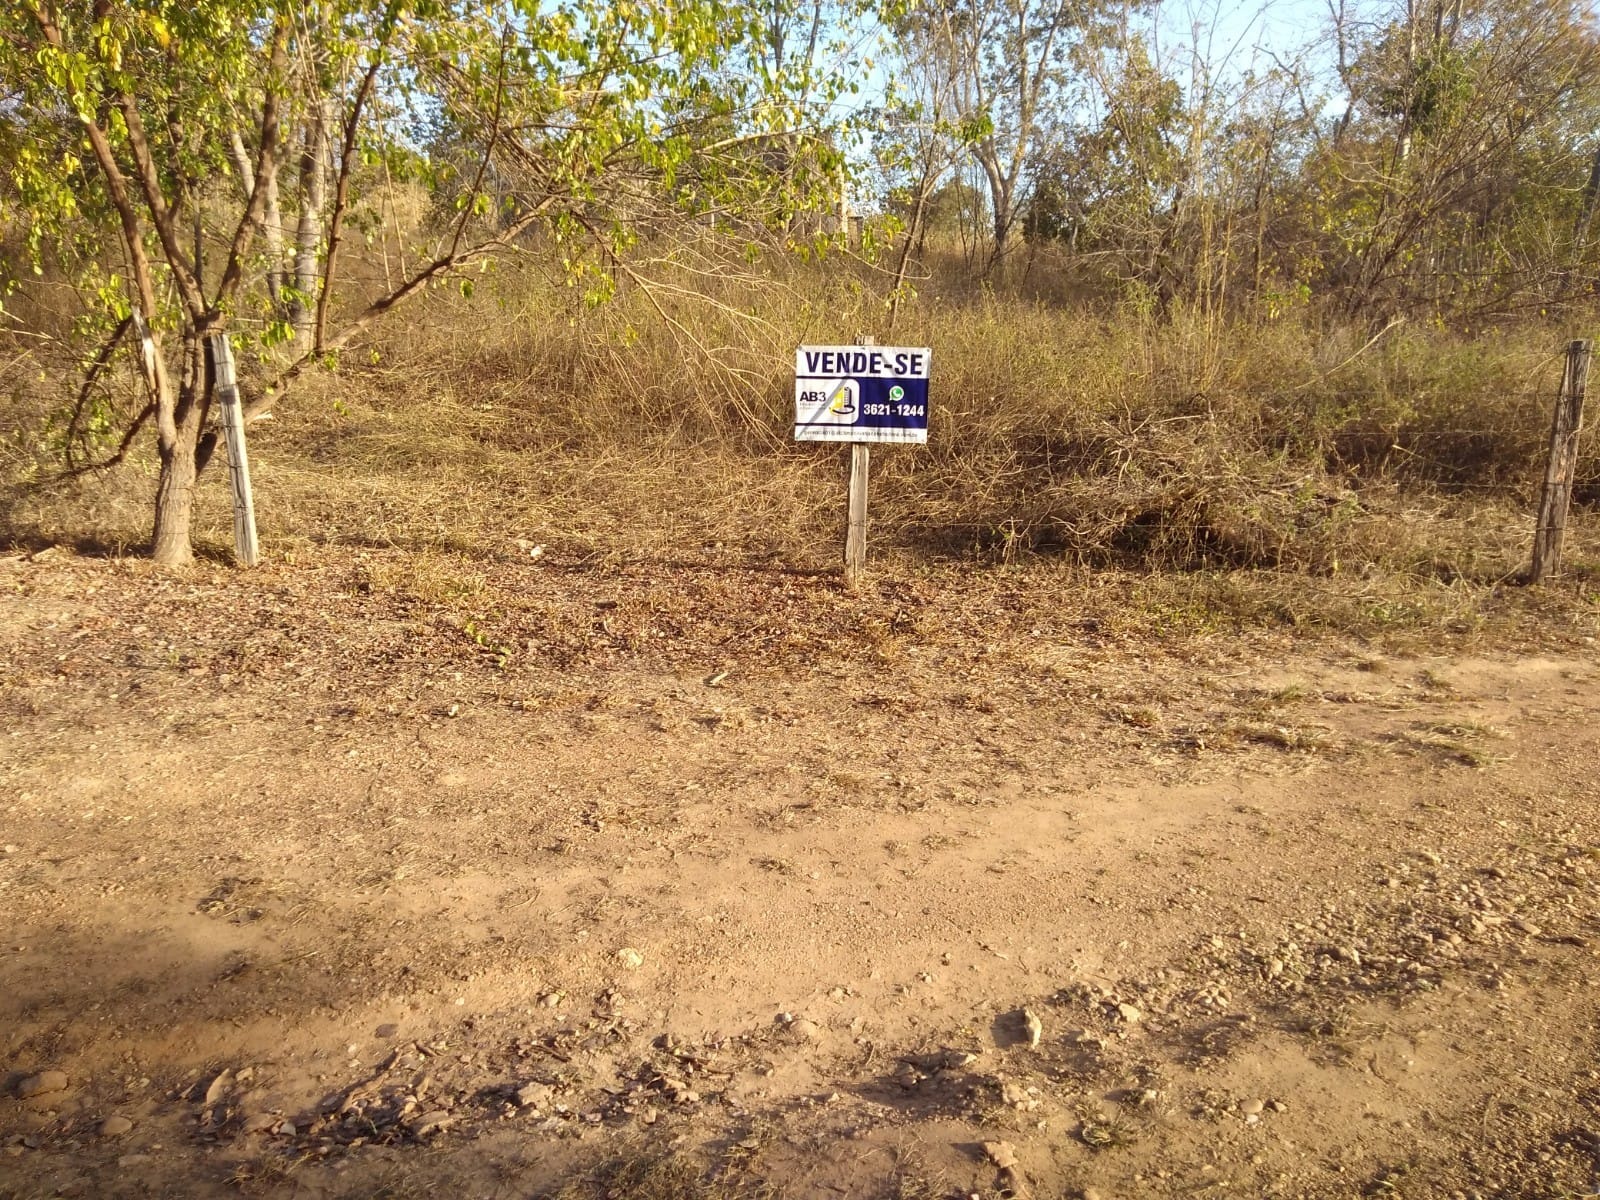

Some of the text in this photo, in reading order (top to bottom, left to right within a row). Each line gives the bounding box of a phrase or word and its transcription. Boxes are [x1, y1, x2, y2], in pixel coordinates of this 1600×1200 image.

[805, 352, 923, 375] VENDE-SE
[799, 391, 826, 402] AB3
[863, 404, 924, 416] 3621-1244
